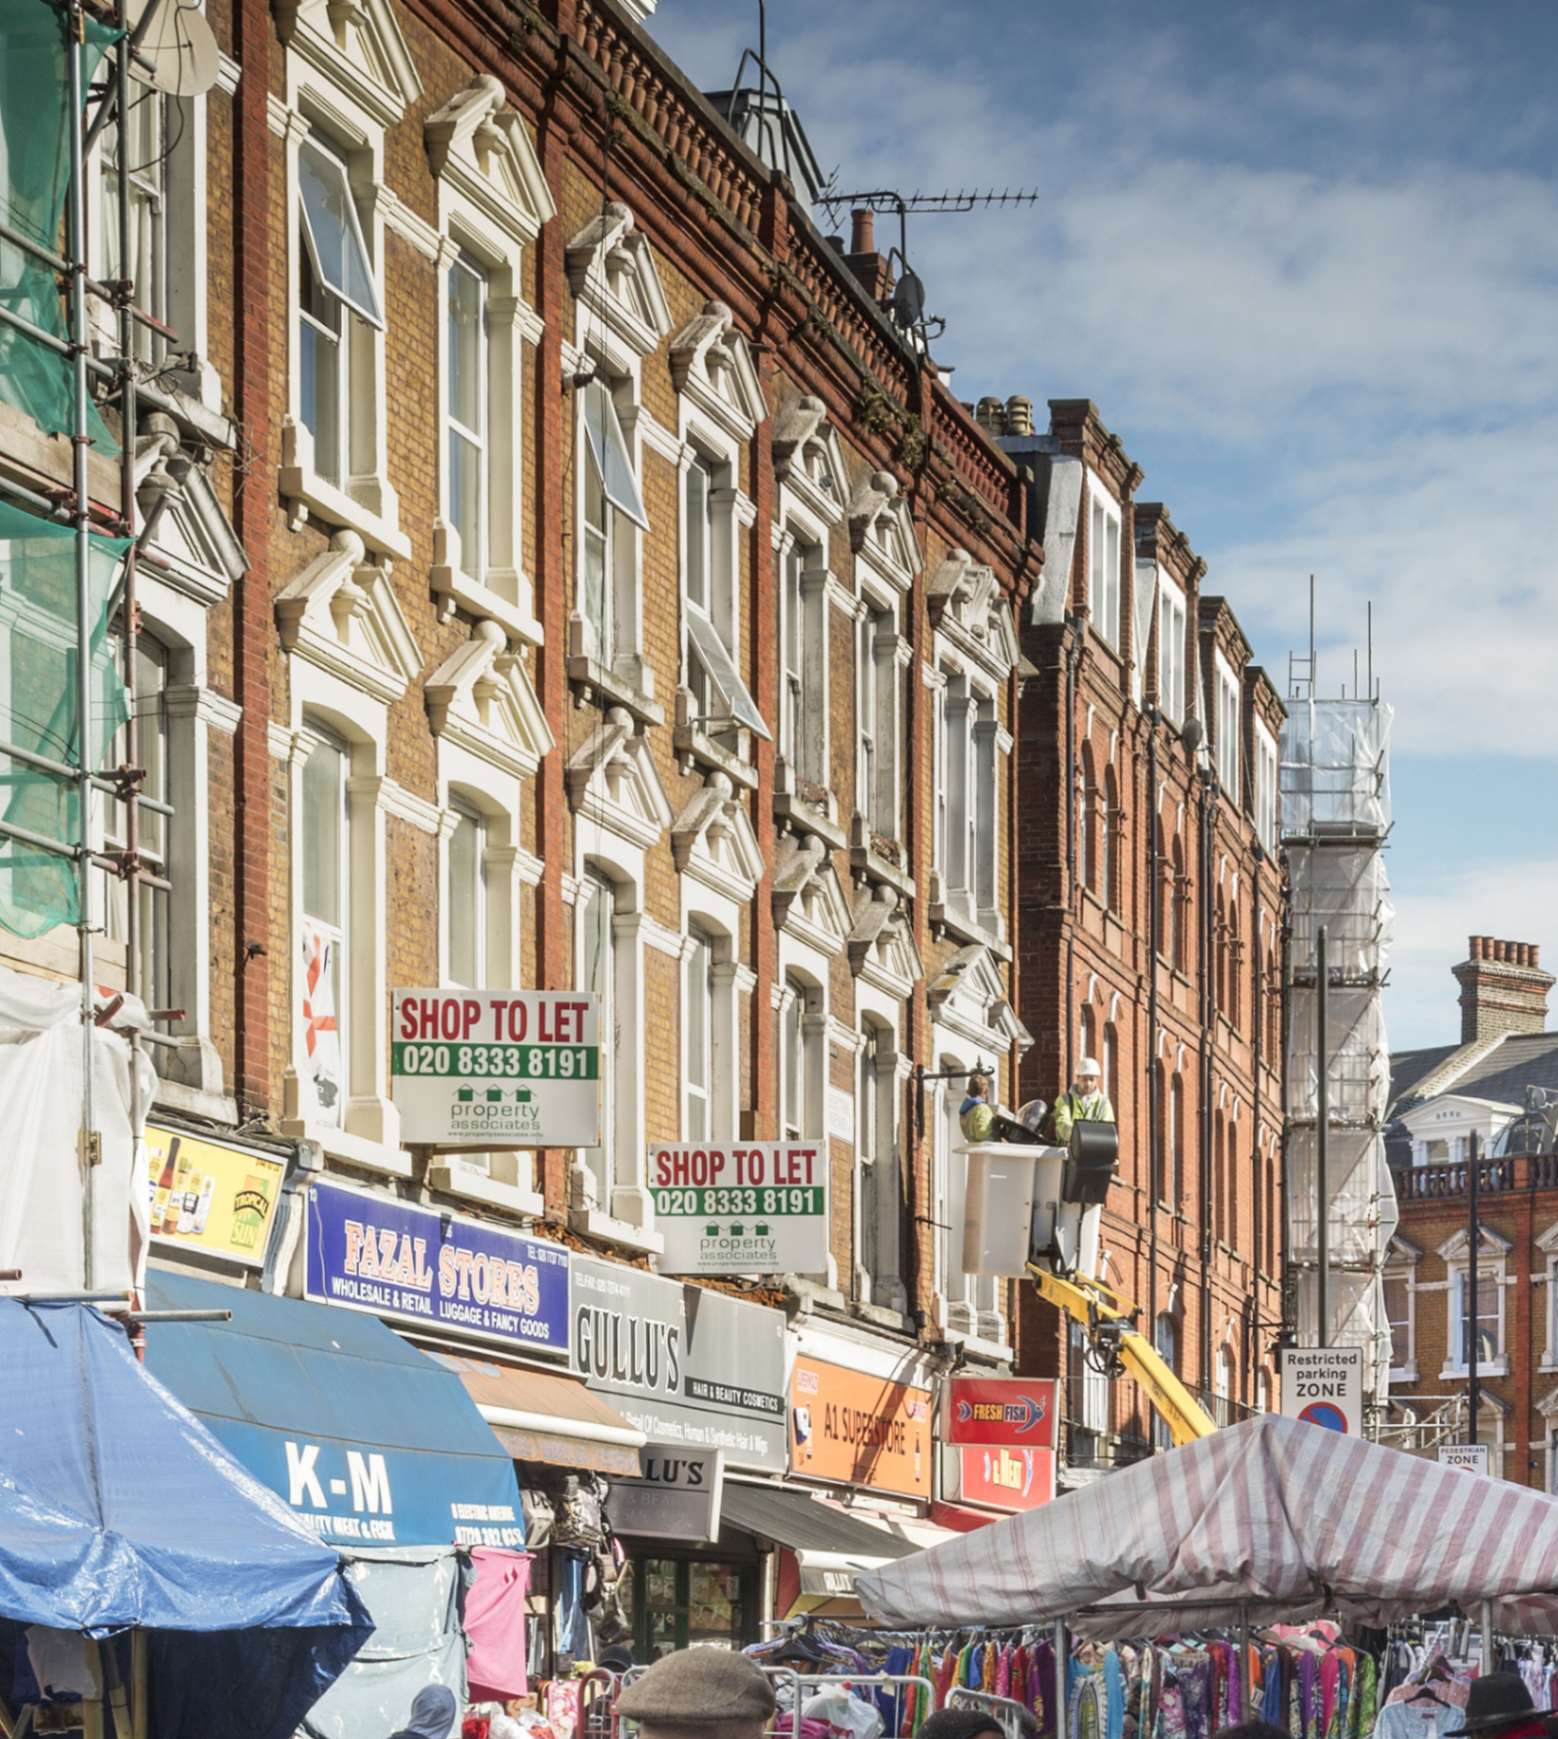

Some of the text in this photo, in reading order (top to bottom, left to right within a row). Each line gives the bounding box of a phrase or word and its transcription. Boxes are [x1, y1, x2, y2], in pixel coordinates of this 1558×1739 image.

[400, 997, 589, 1043] SHOP TO LET
[403, 1045, 588, 1078] 020 8333 8191
[451, 1103, 540, 1121] property
[450, 1119, 541, 1131] associates
[656, 1149, 817, 1187] SHOP TO LET
[234, 1191, 269, 1218] TROPICAL
[657, 1188, 815, 1214] 020 8333 8191
[231, 1221, 257, 1246] SUN
[700, 1238, 776, 1251] property
[344, 1219, 541, 1316] FAZAL STORES
[700, 1250, 777, 1260] associates
[332, 1276, 549, 1340] WHOLESALE & RETAIL LUGGAGE & FANCY GOODS
[576, 1304, 680, 1395] GULLU'S
[1288, 1354, 1357, 1365] Restricted
[1296, 1368, 1347, 1381] parking
[692, 1380, 778, 1412] HAIR & BEAUTY COSMETICS
[1296, 1384, 1347, 1397] ZONE
[973, 1403, 1027, 1422] FRESH FISH
[842, 1407, 906, 1456] SUPERSTORE
[646, 1458, 704, 1484] LU'S
[1447, 1455, 1479, 1464] ZONE
[333, 1516, 361, 1537] MEAT
[361, 1522, 371, 1539] &
[371, 1520, 395, 1540] FISH
